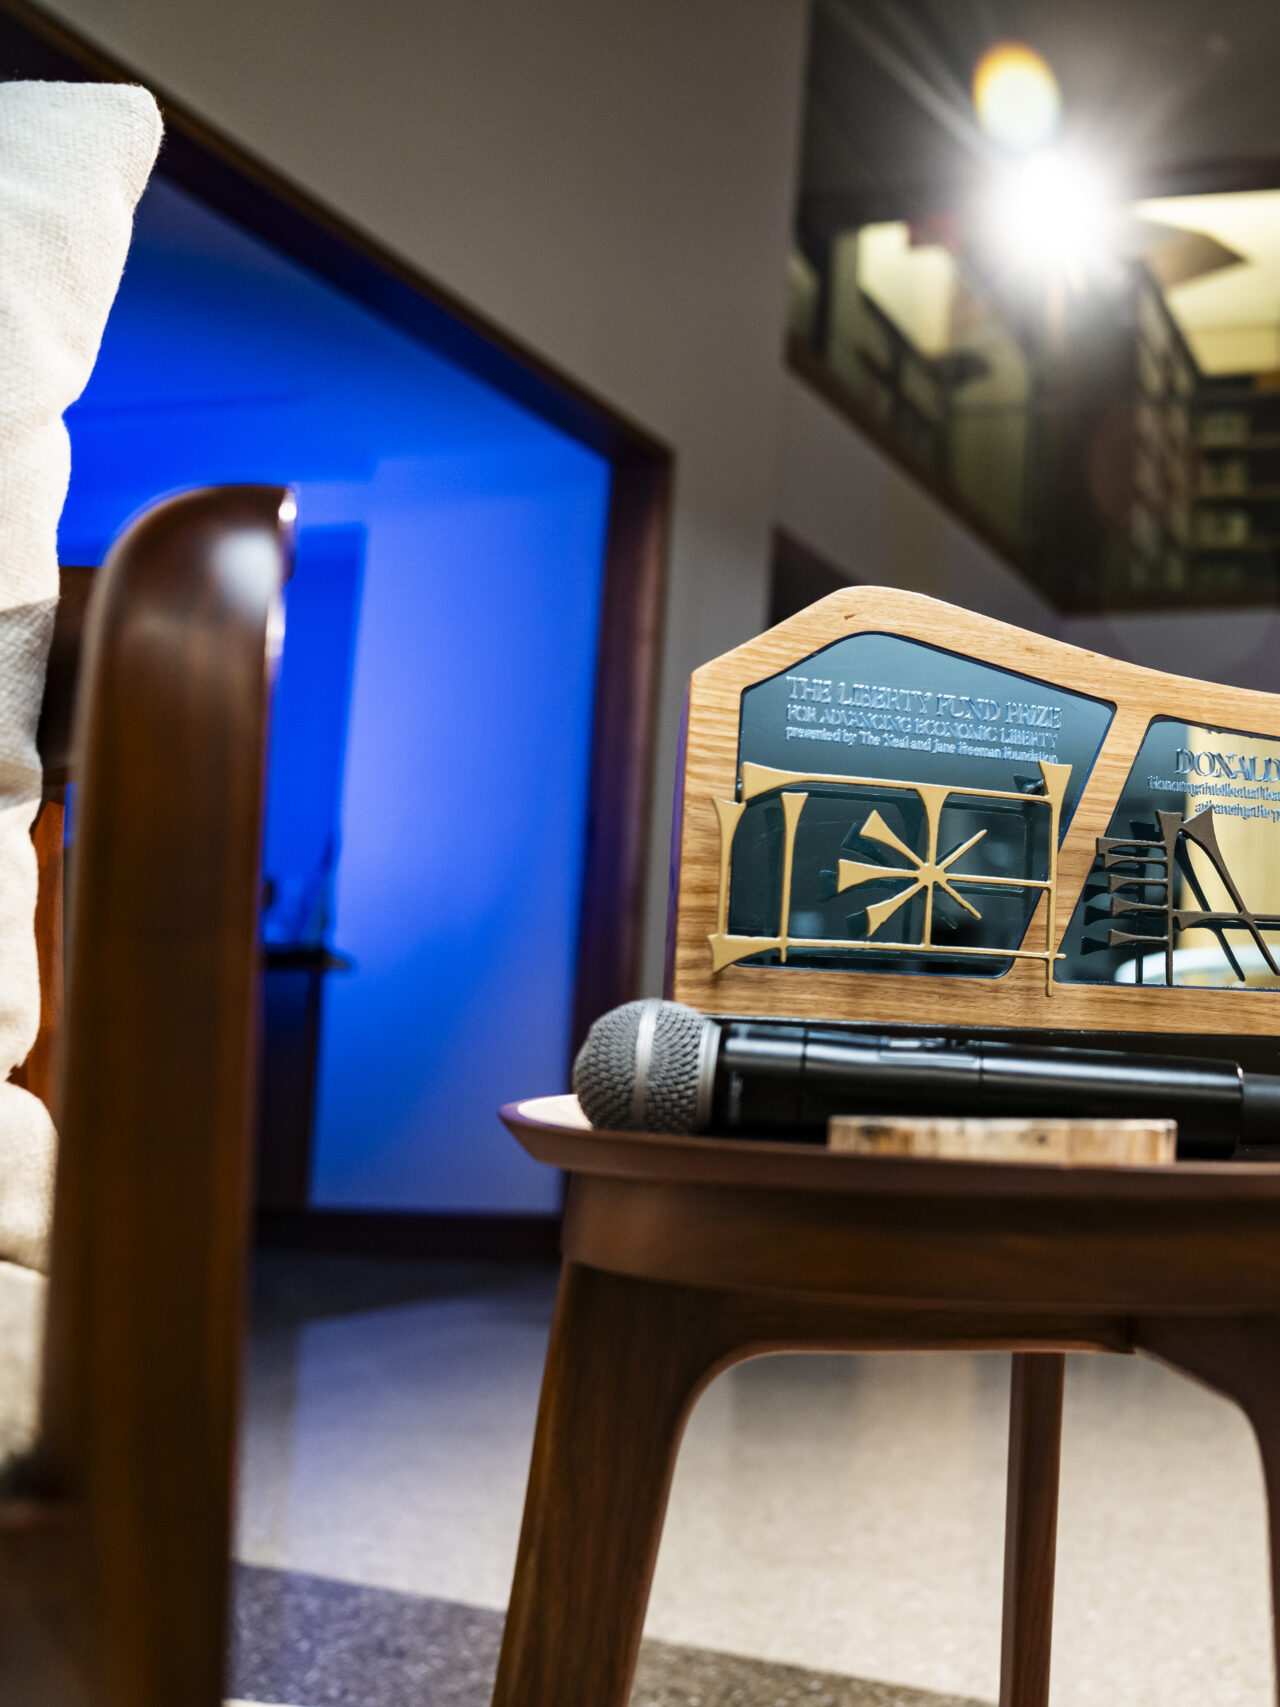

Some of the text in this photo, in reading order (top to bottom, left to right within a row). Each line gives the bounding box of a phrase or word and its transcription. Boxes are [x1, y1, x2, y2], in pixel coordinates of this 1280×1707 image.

[785, 675, 1062, 729] THE LIBERTY FUND PRIZE
[785, 726, 843, 743] presented
[859, 731, 880, 746] The
[910, 737, 931, 752] and
[787, 704, 1058, 749] FOR ADVANCING ECONOMIC LIBERTY
